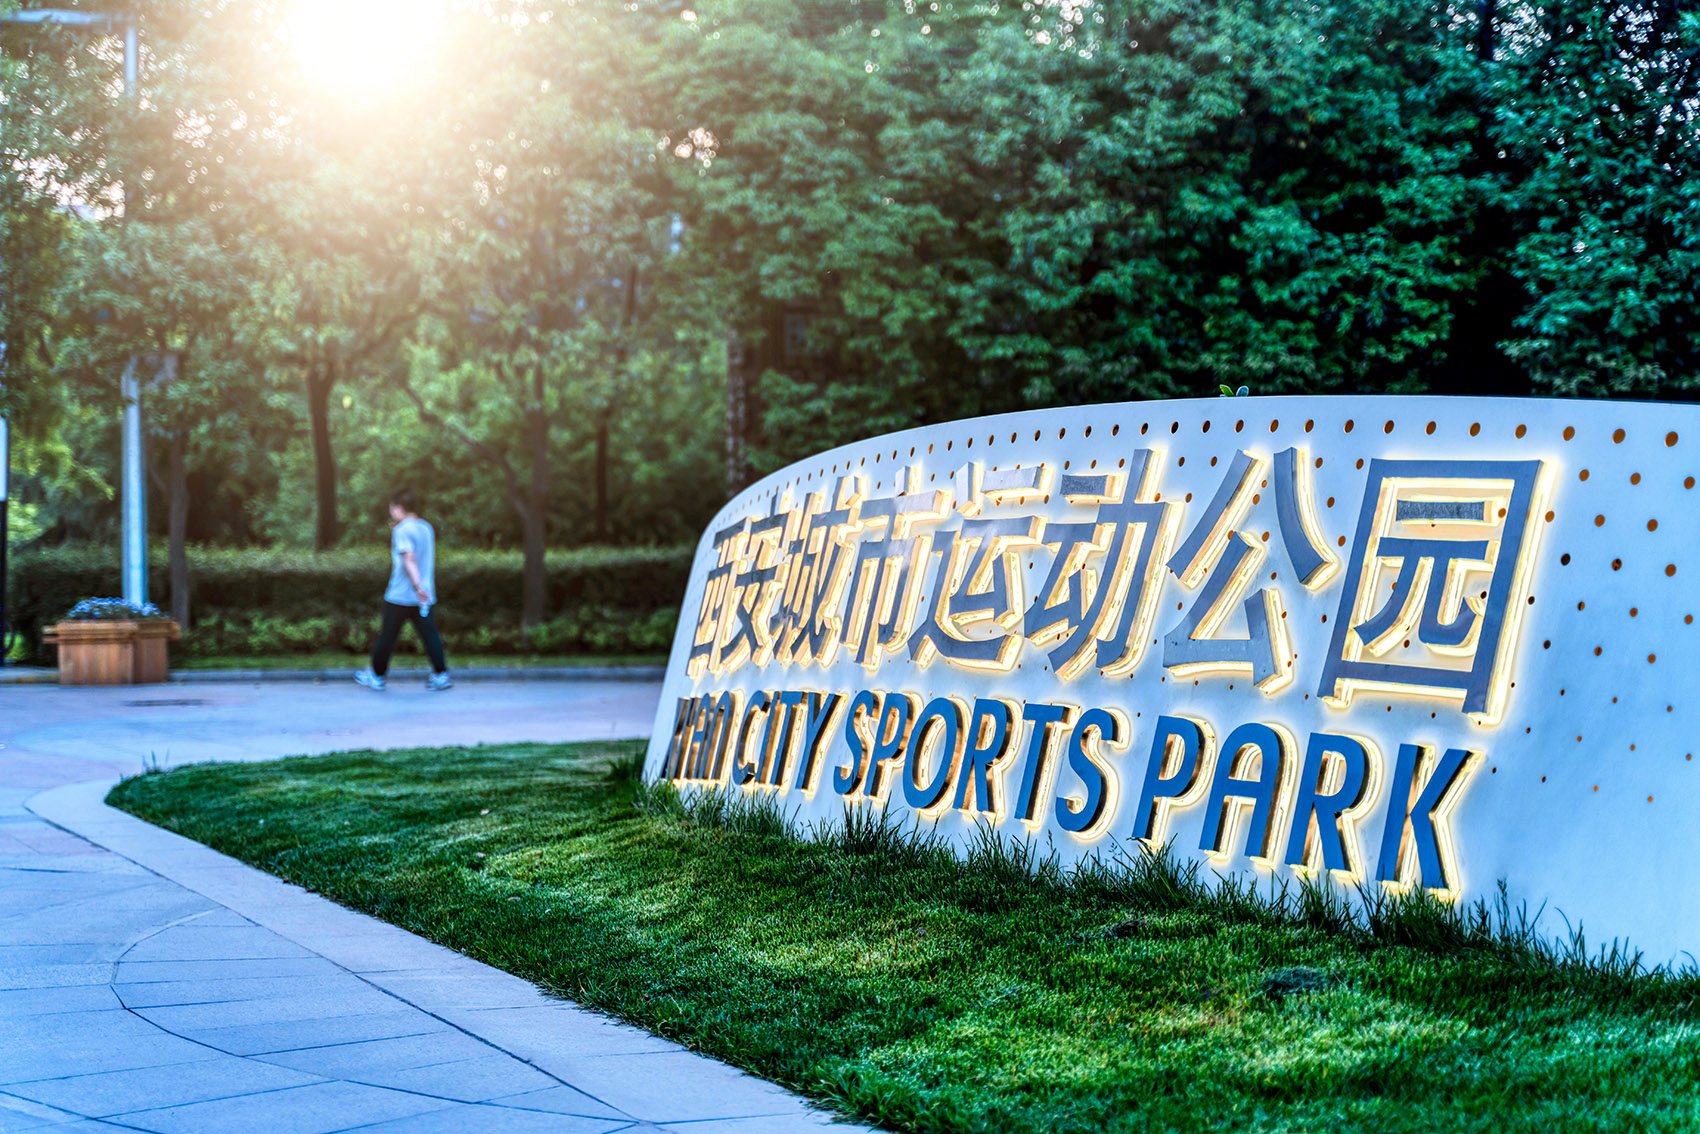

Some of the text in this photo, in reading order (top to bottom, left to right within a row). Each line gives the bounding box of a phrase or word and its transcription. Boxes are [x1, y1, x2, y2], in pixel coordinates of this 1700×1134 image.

[686, 446, 1550, 719] 西安城市运动公园
[732, 689, 846, 791] CITY
[833, 690, 1120, 833] SPORTS
[1131, 714, 1476, 891] PARK
